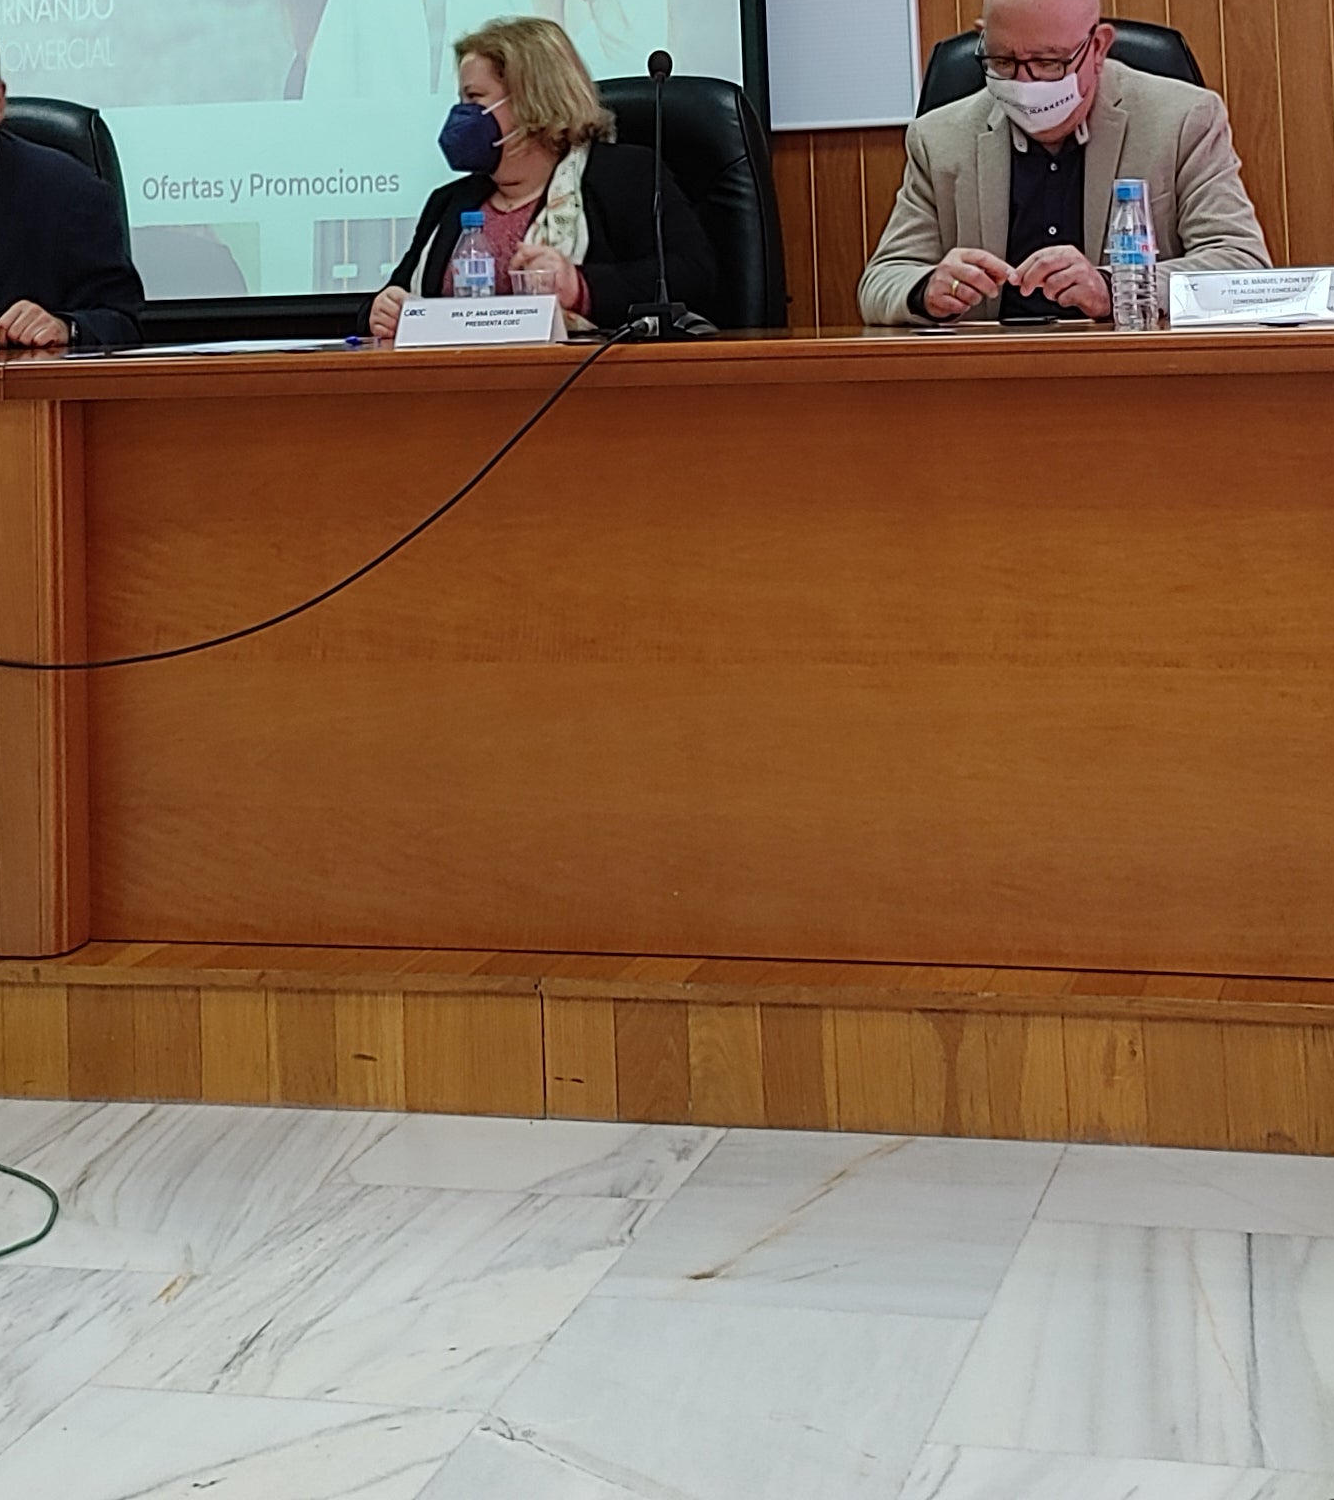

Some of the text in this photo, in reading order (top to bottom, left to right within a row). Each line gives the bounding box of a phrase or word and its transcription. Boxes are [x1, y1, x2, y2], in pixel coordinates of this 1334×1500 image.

[0, 35, 116, 73] OMERCIAL
[142, 168, 400, 204] Ofertas y Promociones
